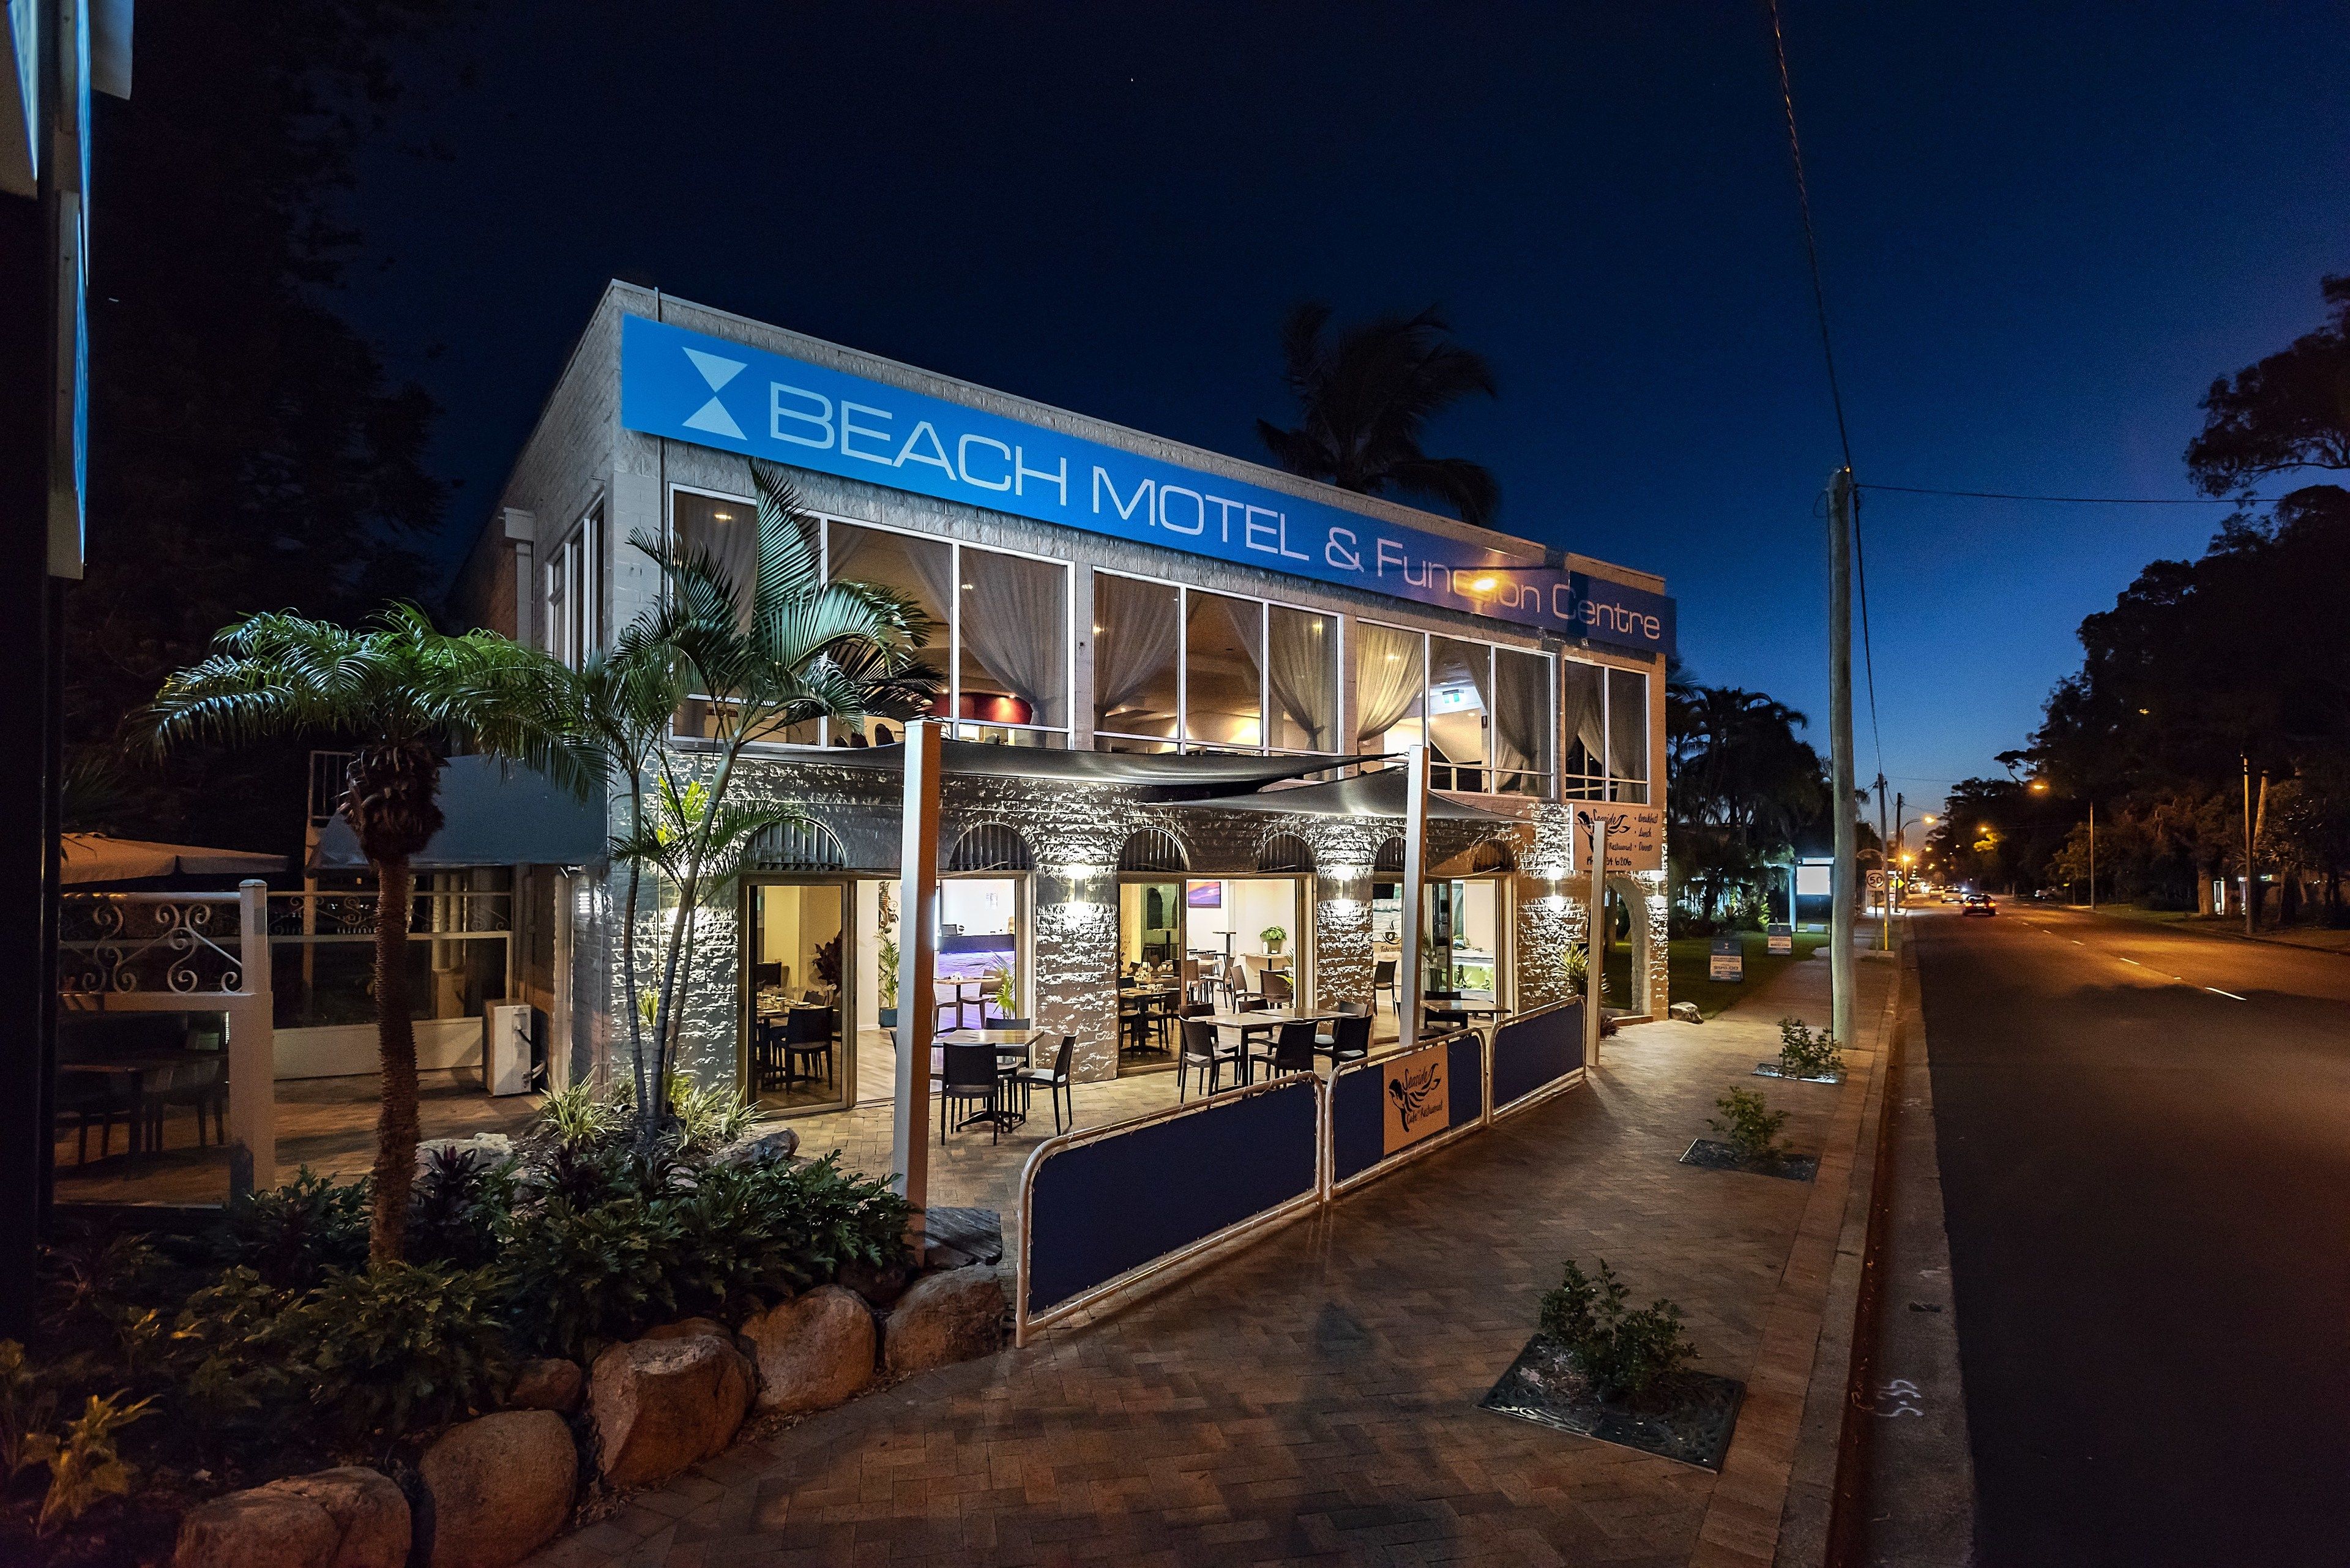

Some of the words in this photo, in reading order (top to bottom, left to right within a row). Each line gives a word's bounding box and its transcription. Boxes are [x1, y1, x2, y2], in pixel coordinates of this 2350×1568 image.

[770, 381, 1067, 506] BEACH
[1092, 465, 1310, 561] MOTEL
[1325, 526, 1365, 573] &
[1552, 583, 1660, 640] Centre
[1615, 857, 1632, 866] 6206
[1402, 1066, 1428, 1091] Seaside
